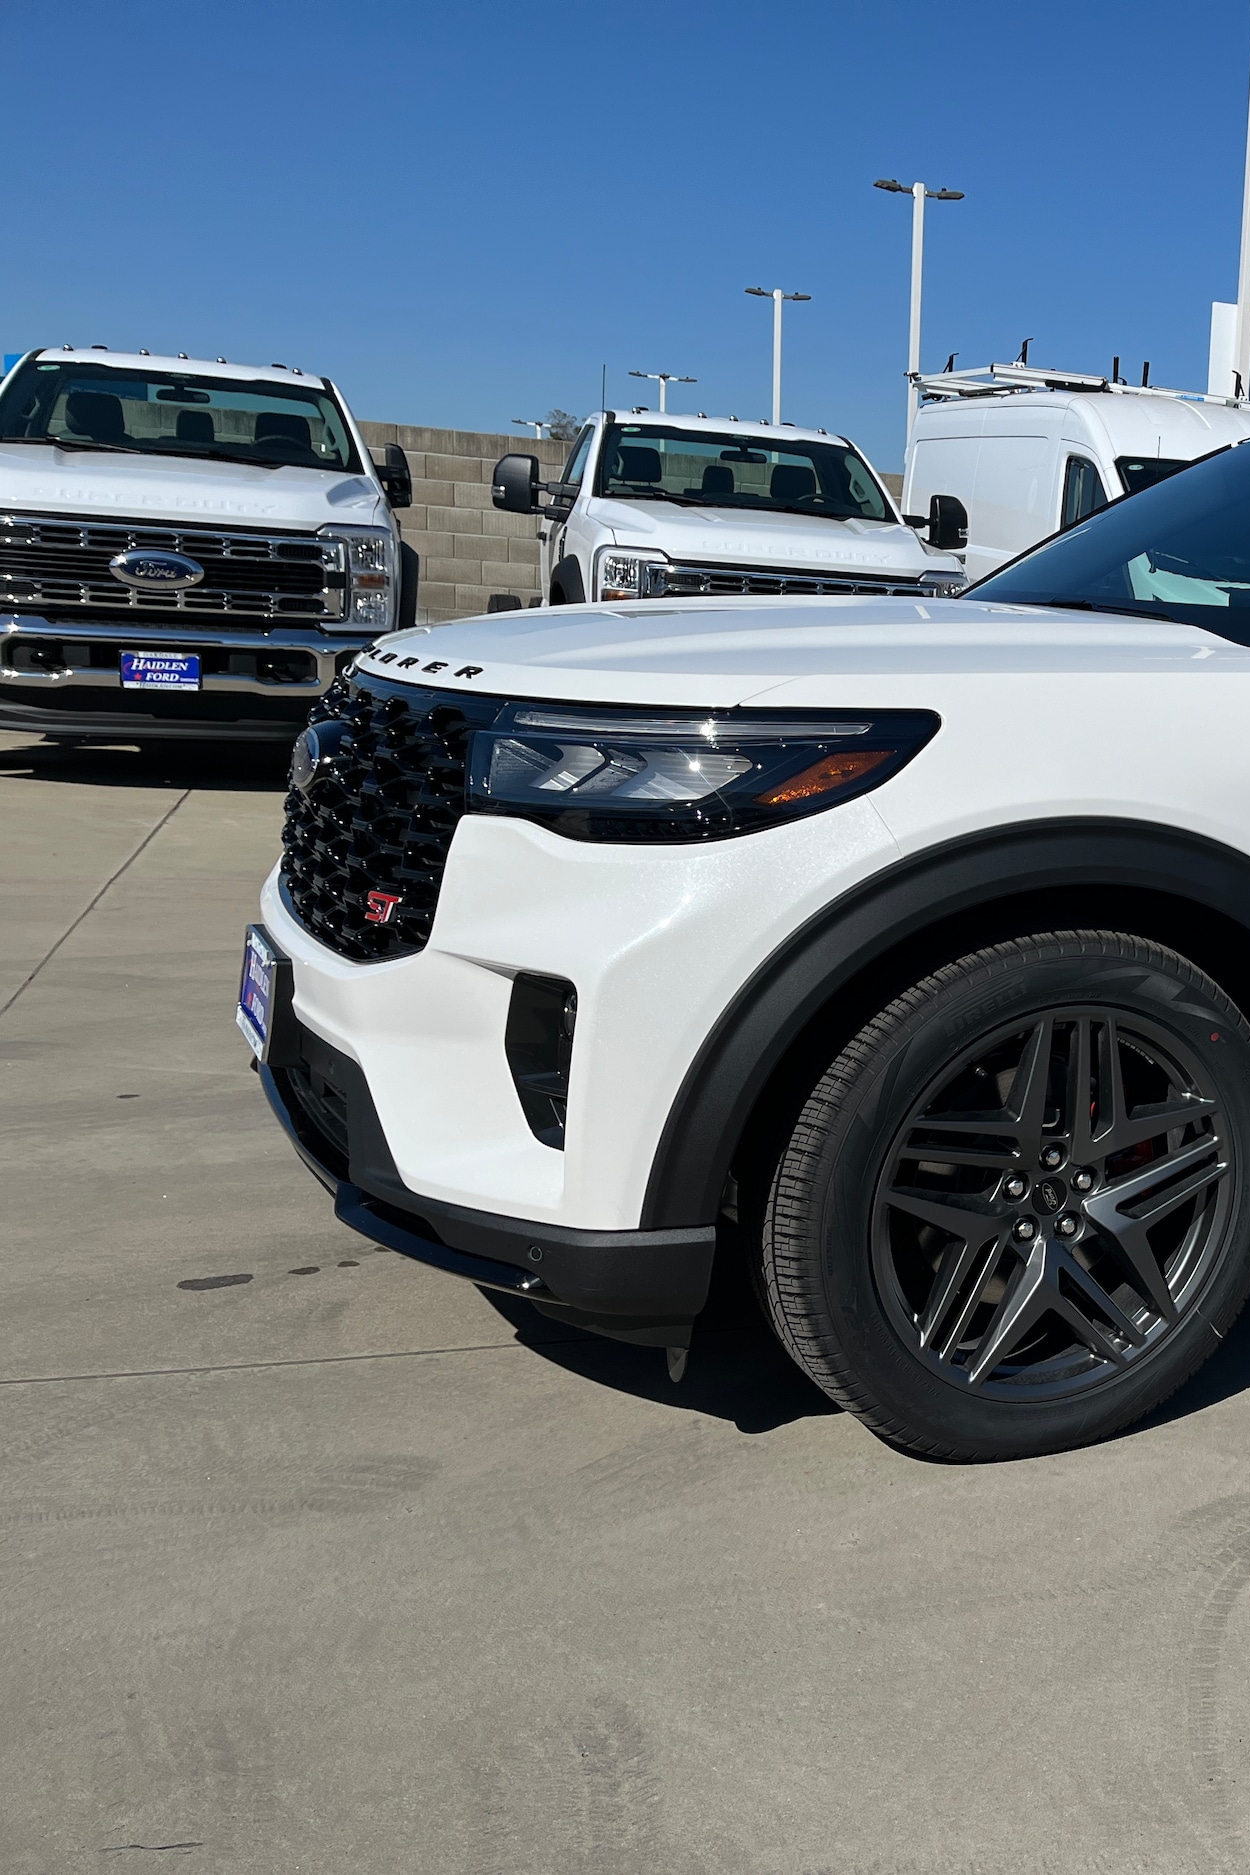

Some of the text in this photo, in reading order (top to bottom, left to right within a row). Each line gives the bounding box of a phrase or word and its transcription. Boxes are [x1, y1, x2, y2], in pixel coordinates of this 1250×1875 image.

[131, 658, 189, 671] HAIDLEN
[145, 672, 180, 682] FORD
[365, 890, 403, 924] ST
